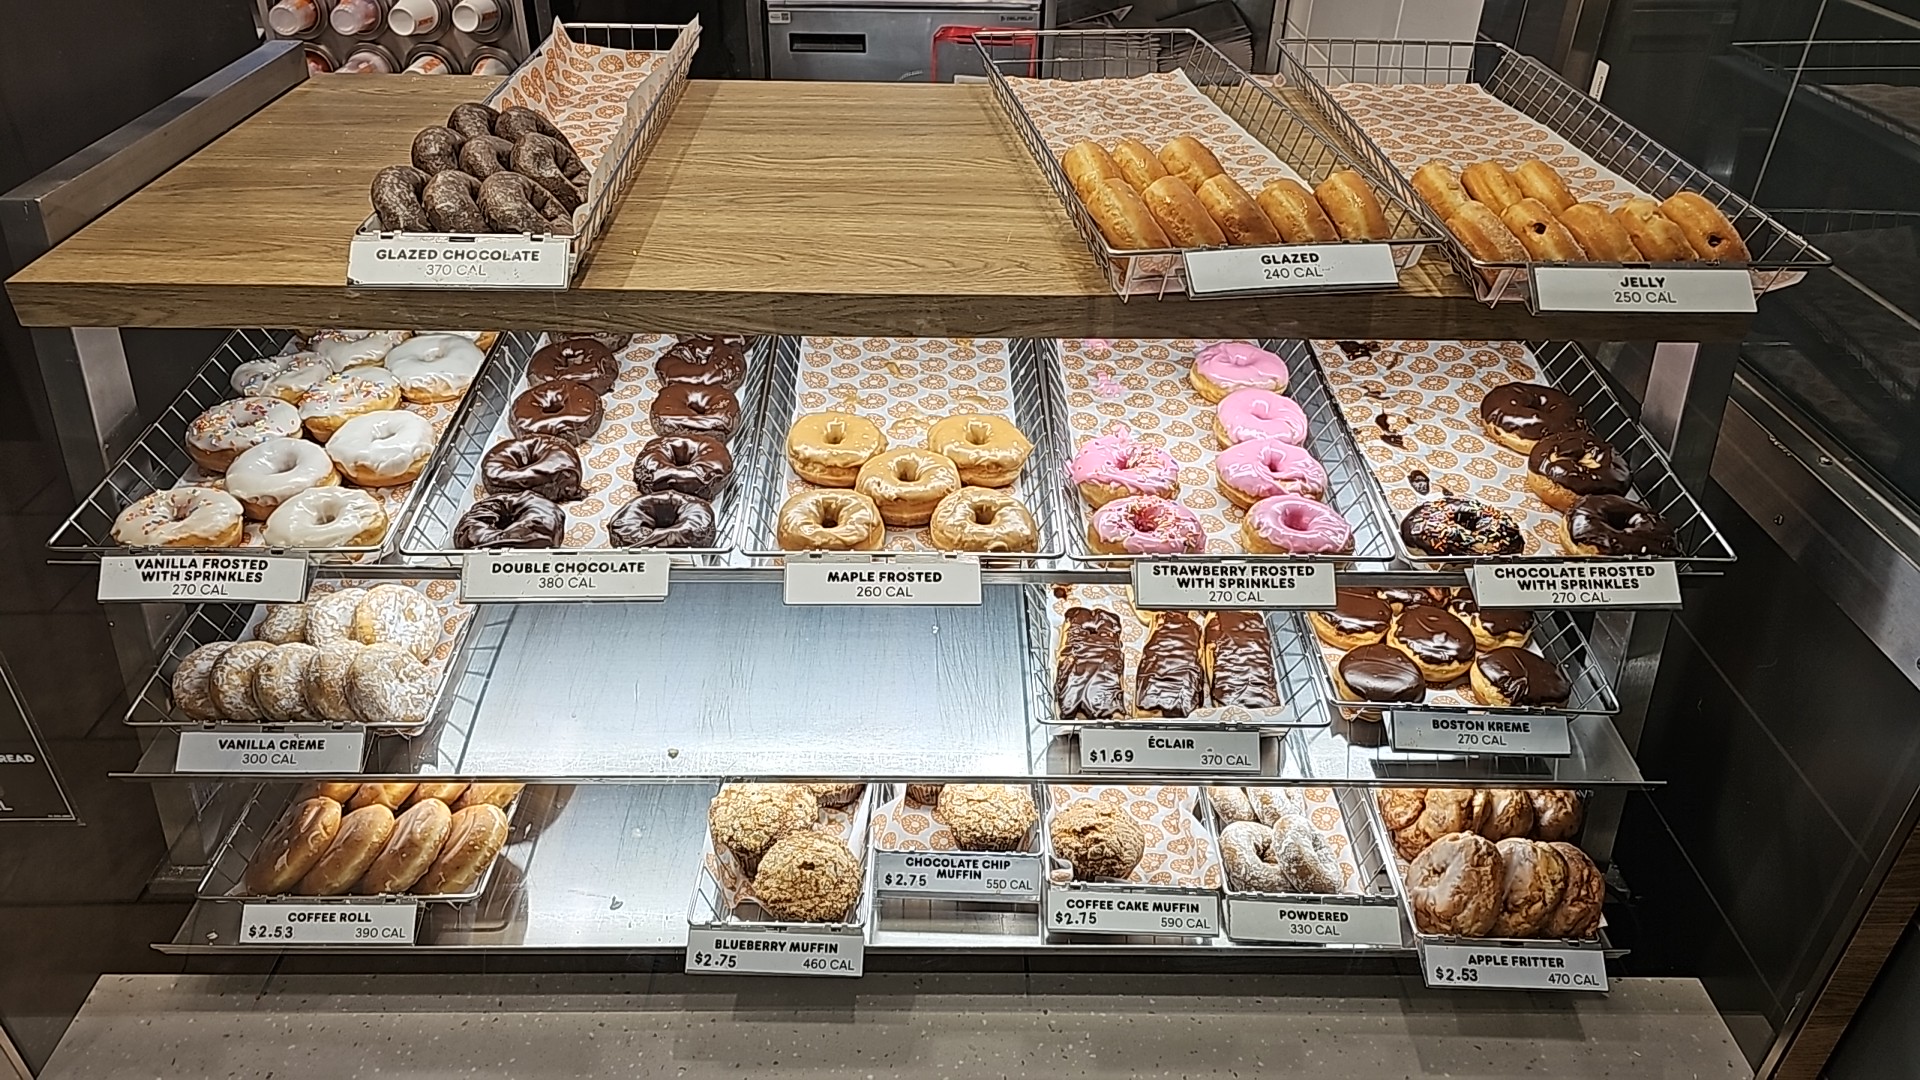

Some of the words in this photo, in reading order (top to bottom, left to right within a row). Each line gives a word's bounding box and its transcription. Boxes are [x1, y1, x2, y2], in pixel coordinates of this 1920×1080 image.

[376, 249, 438, 260] GLAZED
[442, 250, 540, 261] CHOCOLATE
[1261, 253, 1319, 264] GLAZED
[425, 265, 452, 276] 370
[456, 265, 486, 276] CAL
[1264, 268, 1290, 279] 240
[1293, 266, 1323, 278] CAL
[1620, 277, 1665, 288] JELLY
[1615, 292, 1642, 303] 250
[1645, 292, 1677, 303] CAL
[135, 559, 197, 569] VANILLA
[203, 559, 268, 570] FROSTED
[492, 562, 550, 573] DOUBLE
[554, 562, 645, 573] CHOCOLATE
[142, 571, 180, 582] WITH
[184, 571, 263, 582] SPRINKLES
[1153, 566, 1247, 576] STRAWBERRY
[1251, 566, 1315, 576] FROSTED
[1495, 567, 1586, 579] CHOCOLATE
[1590, 566, 1655, 577] FROSTED
[538, 577, 565, 588] 380
[568, 577, 596, 588] CAL
[827, 572, 875, 582] MAPLE
[879, 572, 942, 582] FROSTED
[1176, 578, 1215, 588] WITH
[1219, 578, 1295, 588] SPRINKLES
[1517, 580, 1556, 590] WITH
[1561, 578, 1639, 590] SPRINKLES
[172, 584, 197, 595] 270
[200, 584, 228, 595] CAL
[856, 587, 882, 597] 260
[885, 587, 913, 597] CAL
[1209, 591, 1233, 602] 270
[1236, 591, 1265, 602] CAL
[1552, 593, 1577, 603] 270
[1580, 592, 1609, 603] CAL
[1432, 719, 1485, 731] BOSTON
[1488, 721, 1531, 732] KREME
[218, 739, 276, 750] VANILLA
[279, 739, 326, 750] CREME
[1148, 736, 1195, 749] ÉCLAIR
[1458, 734, 1479, 744] 270
[1481, 735, 1507, 746] CAL
[242, 754, 268, 764] 300
[271, 754, 297, 764] CAL
[1089, 749, 1134, 763] $1.69
[1201, 755, 1223, 765] 370
[1226, 755, 1252, 766] CAL
[905, 857, 980, 869] CHOCOLATE
[982, 859, 1011, 870] CHIP
[885, 873, 927, 886] $2.75
[936, 869, 982, 880] MUFFIN
[986, 879, 1006, 890] 550
[1009, 879, 1033, 890] CAL
[1066, 899, 1114, 910] COFFEE
[1116, 901, 1149, 912] CAKE
[1152, 902, 1200, 913] MUFFIN
[287, 912, 336, 922] COFFEE
[339, 912, 372, 922] ROLL
[1055, 911, 1097, 925] $2.75
[1279, 909, 1349, 922] POWDERED
[1160, 917, 1183, 928] 590
[1186, 918, 1211, 929] CAL
[248, 925, 294, 938] $2.53
[355, 928, 378, 938] 390
[381, 928, 406, 938] CAL
[1290, 924, 1312, 935] 330
[1315, 924, 1340, 936] CAL
[715, 939, 787, 951] BLUEBERRY
[789, 942, 838, 954] MUFFIN
[694, 953, 737, 967] $2.75
[803, 958, 827, 969] 460
[829, 959, 855, 971] CAL
[1468, 954, 1509, 966] APPLE
[1512, 956, 1564, 968] FRITTER
[1435, 967, 1478, 982] $2.53
[1548, 973, 1571, 984] 470
[1573, 974, 1599, 986] CAL
